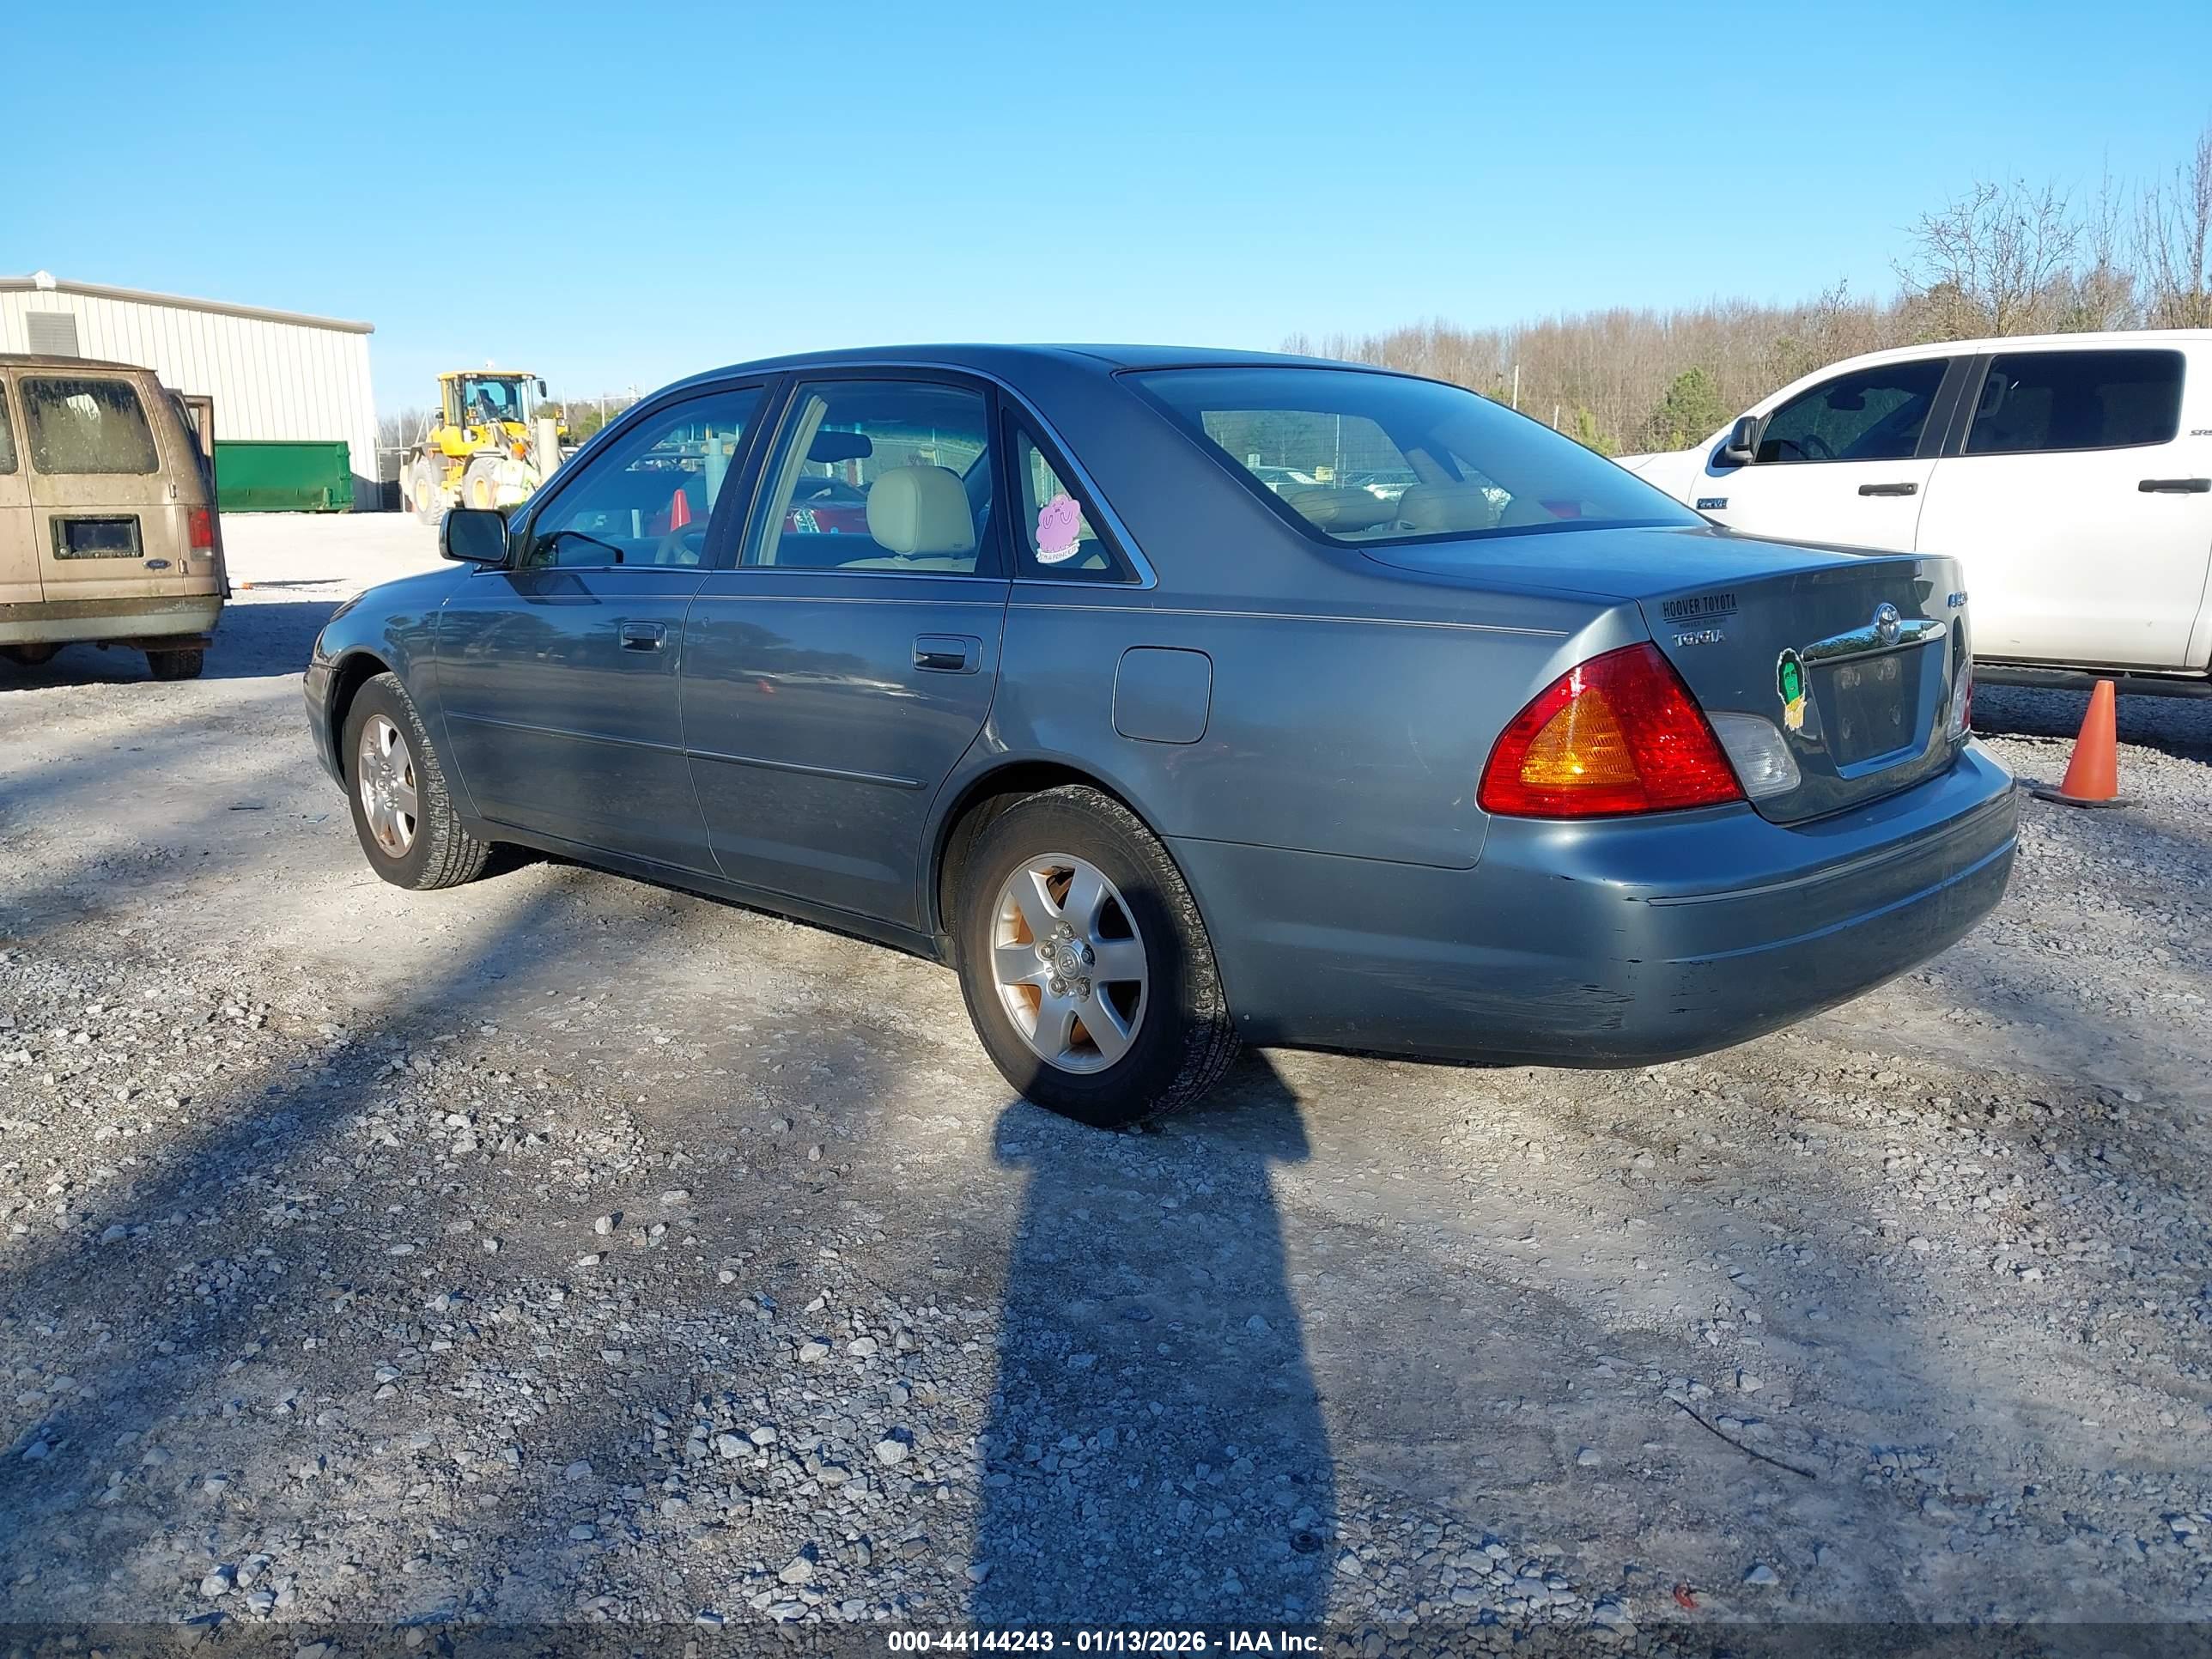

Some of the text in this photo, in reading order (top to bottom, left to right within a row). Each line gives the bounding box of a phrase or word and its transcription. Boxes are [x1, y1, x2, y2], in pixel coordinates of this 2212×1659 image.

[1662, 593, 1737, 617] HOOVER TOYOTA
[1672, 629, 1725, 647] TOYOTA
